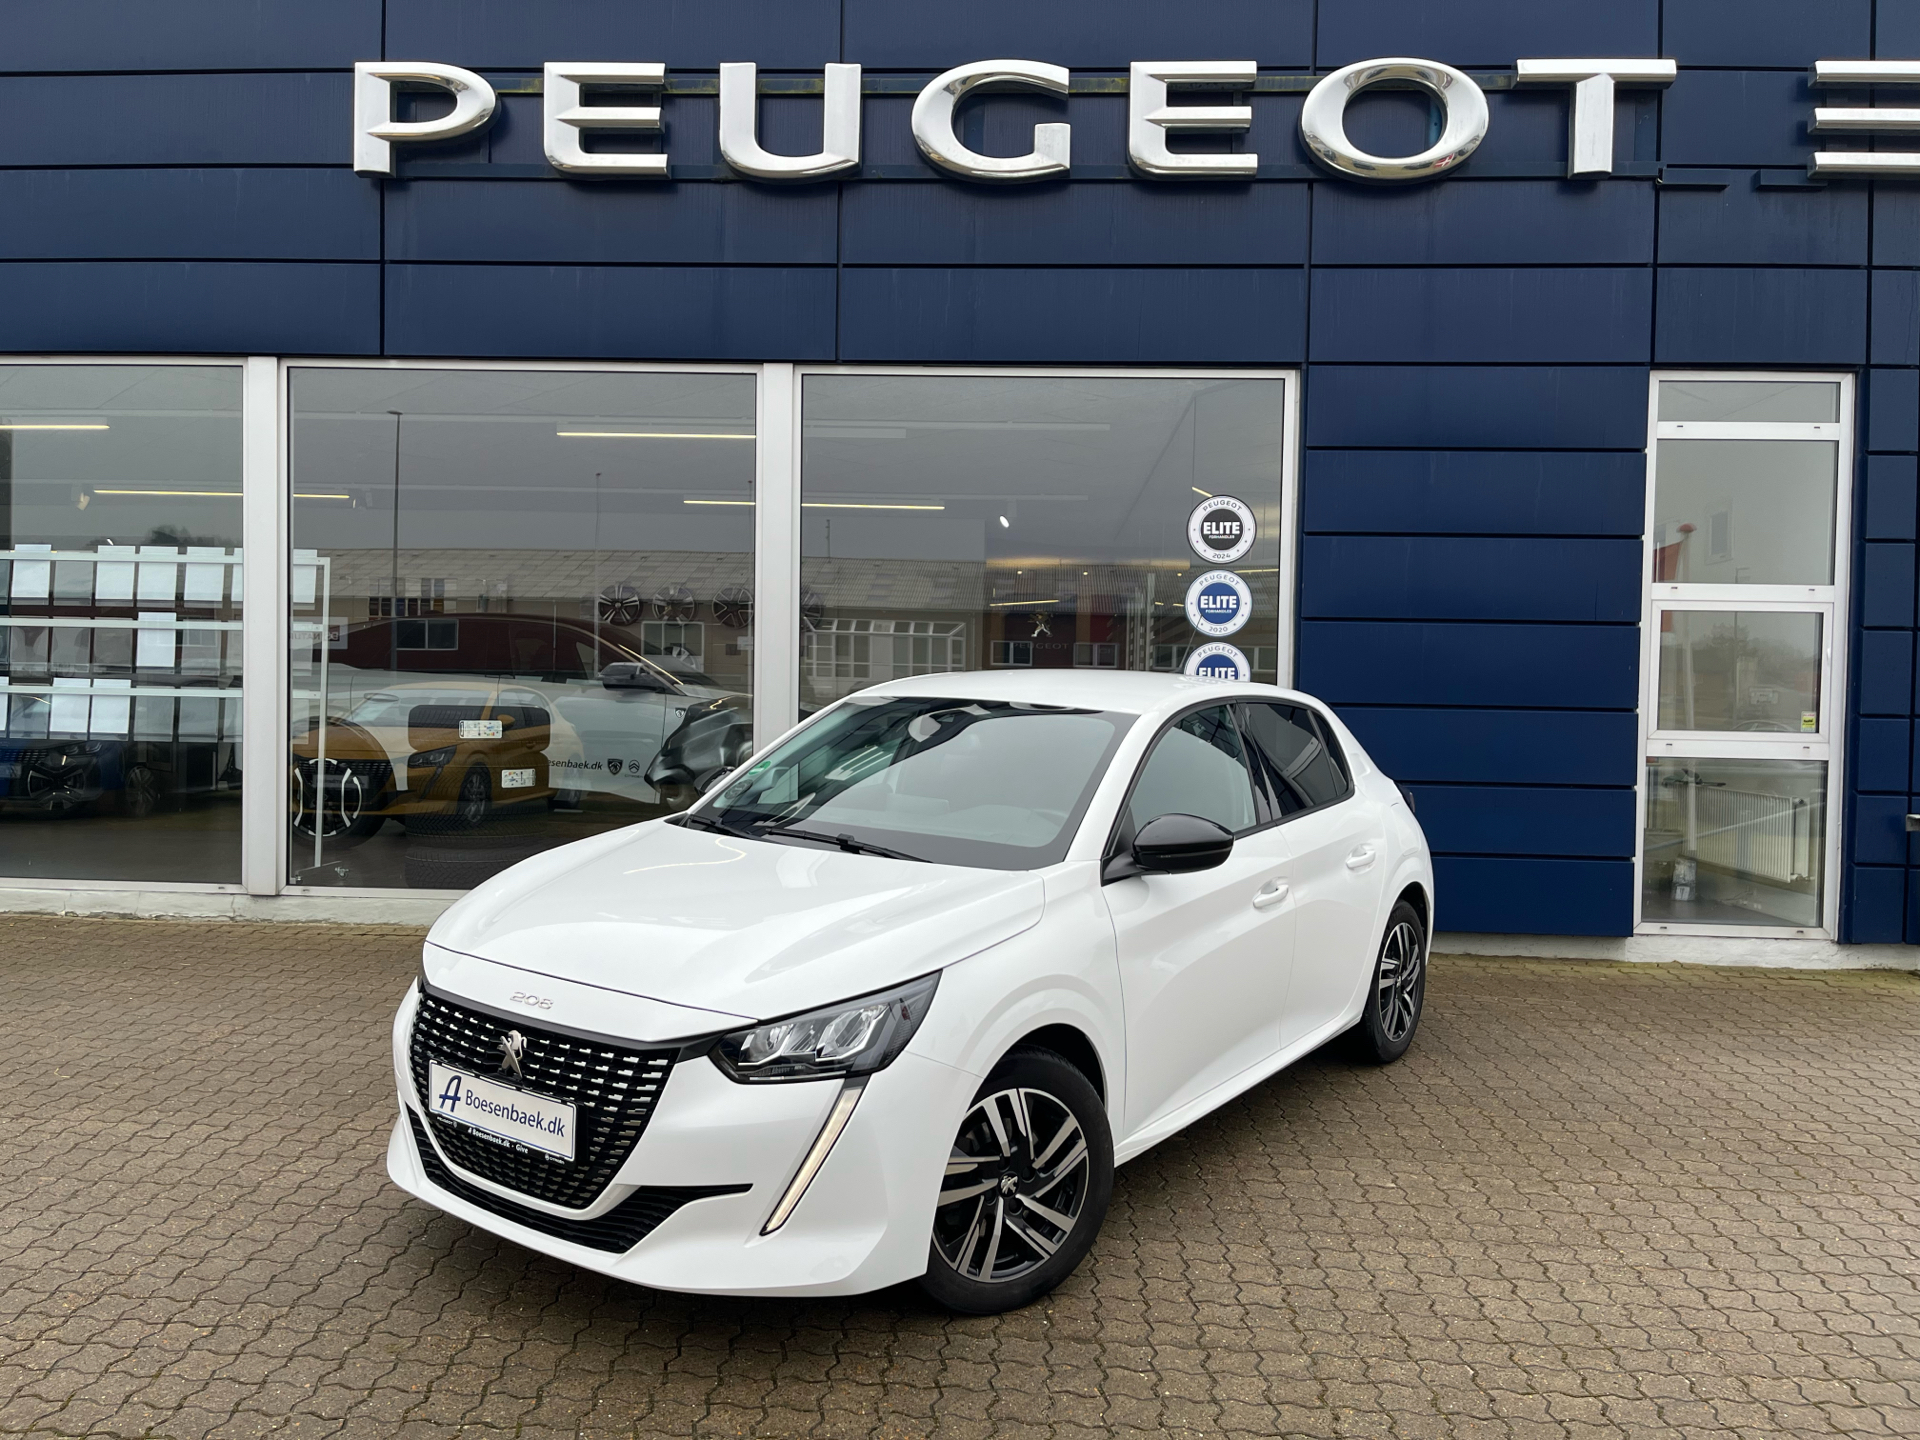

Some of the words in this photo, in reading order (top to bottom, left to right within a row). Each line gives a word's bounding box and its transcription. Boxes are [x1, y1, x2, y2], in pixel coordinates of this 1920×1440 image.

[354, 57, 1677, 183] PEUGEOT
[1202, 499, 1242, 512] PEUGEOT
[1203, 521, 1240, 535] ELITE
[1199, 573, 1240, 586] PEUGEOT
[1200, 595, 1237, 609] ELITE
[1197, 645, 1239, 658] PEUGEOT
[1199, 667, 1236, 680] ELITE
[510, 991, 554, 1010] 208
[465, 1089, 566, 1138] Boesenbaek.dk
[515, 1144, 529, 1154] Give
